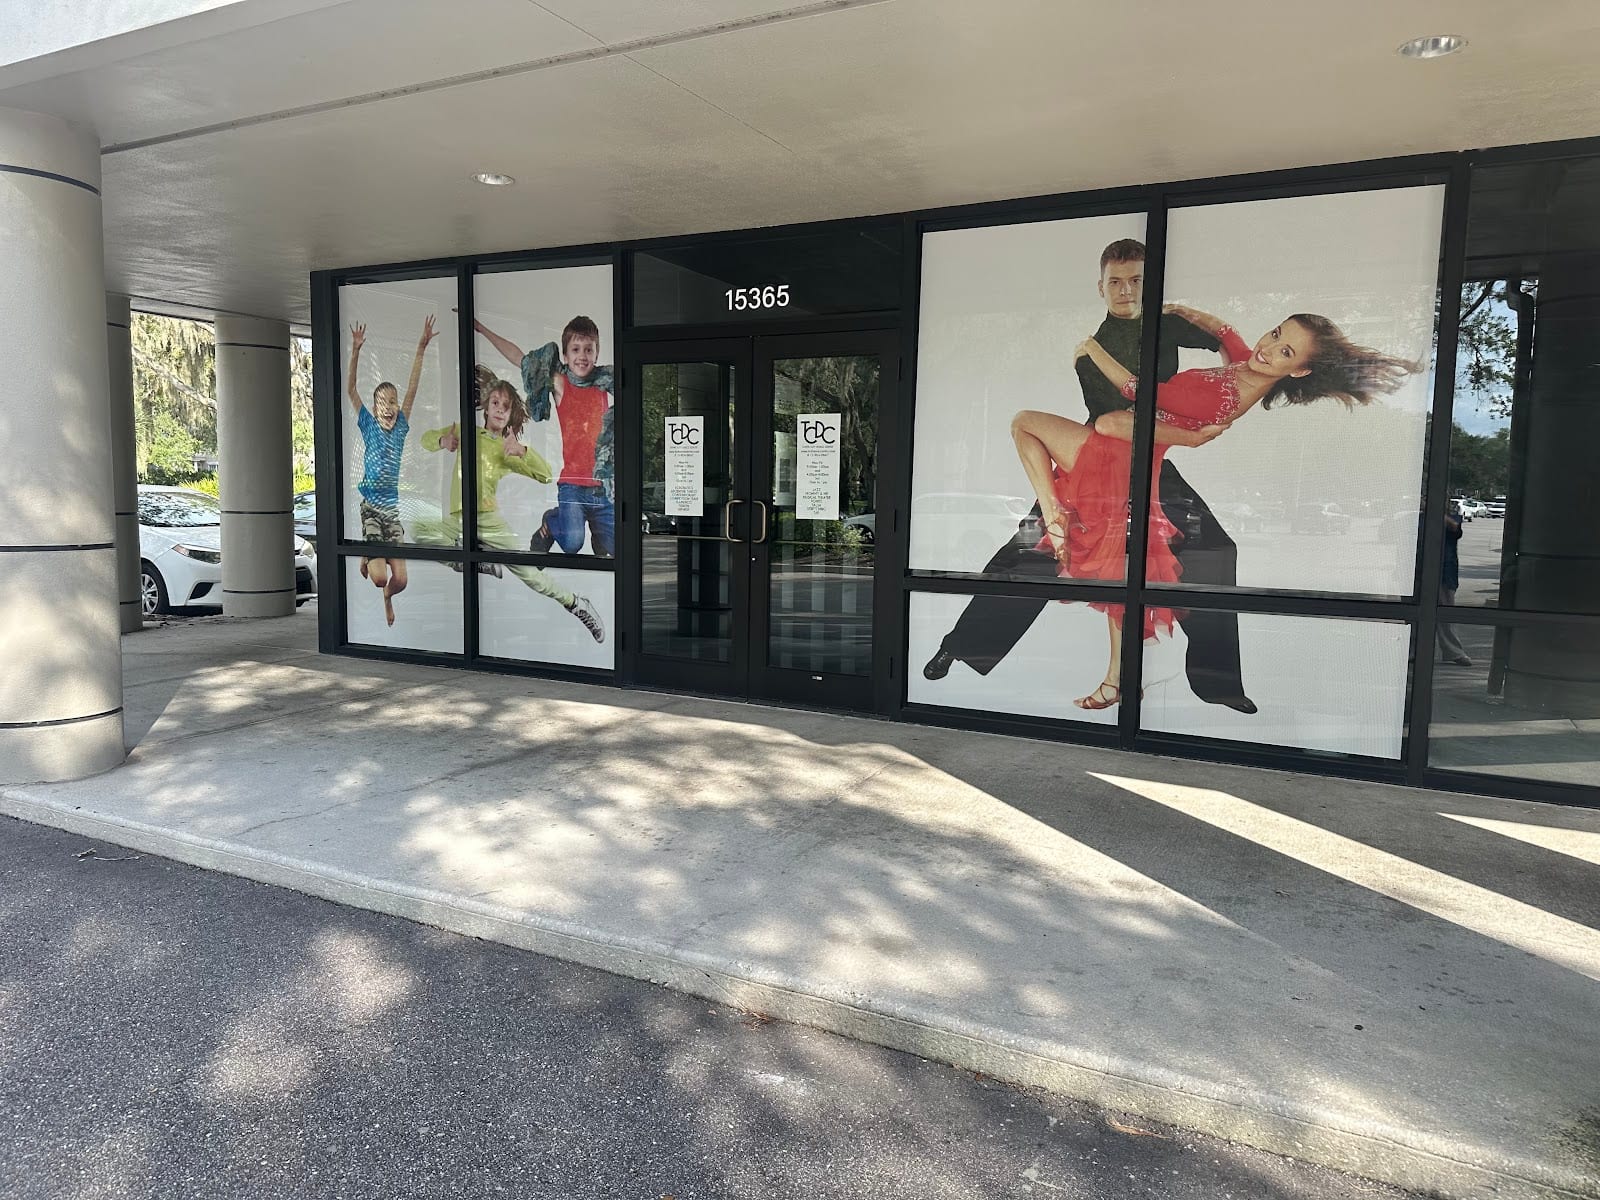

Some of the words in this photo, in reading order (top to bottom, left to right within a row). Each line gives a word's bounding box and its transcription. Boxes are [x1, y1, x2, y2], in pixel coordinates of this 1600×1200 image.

[725, 284, 790, 311] 15365
[667, 423, 700, 445] TCDC
[800, 420, 836, 445] TCDC
